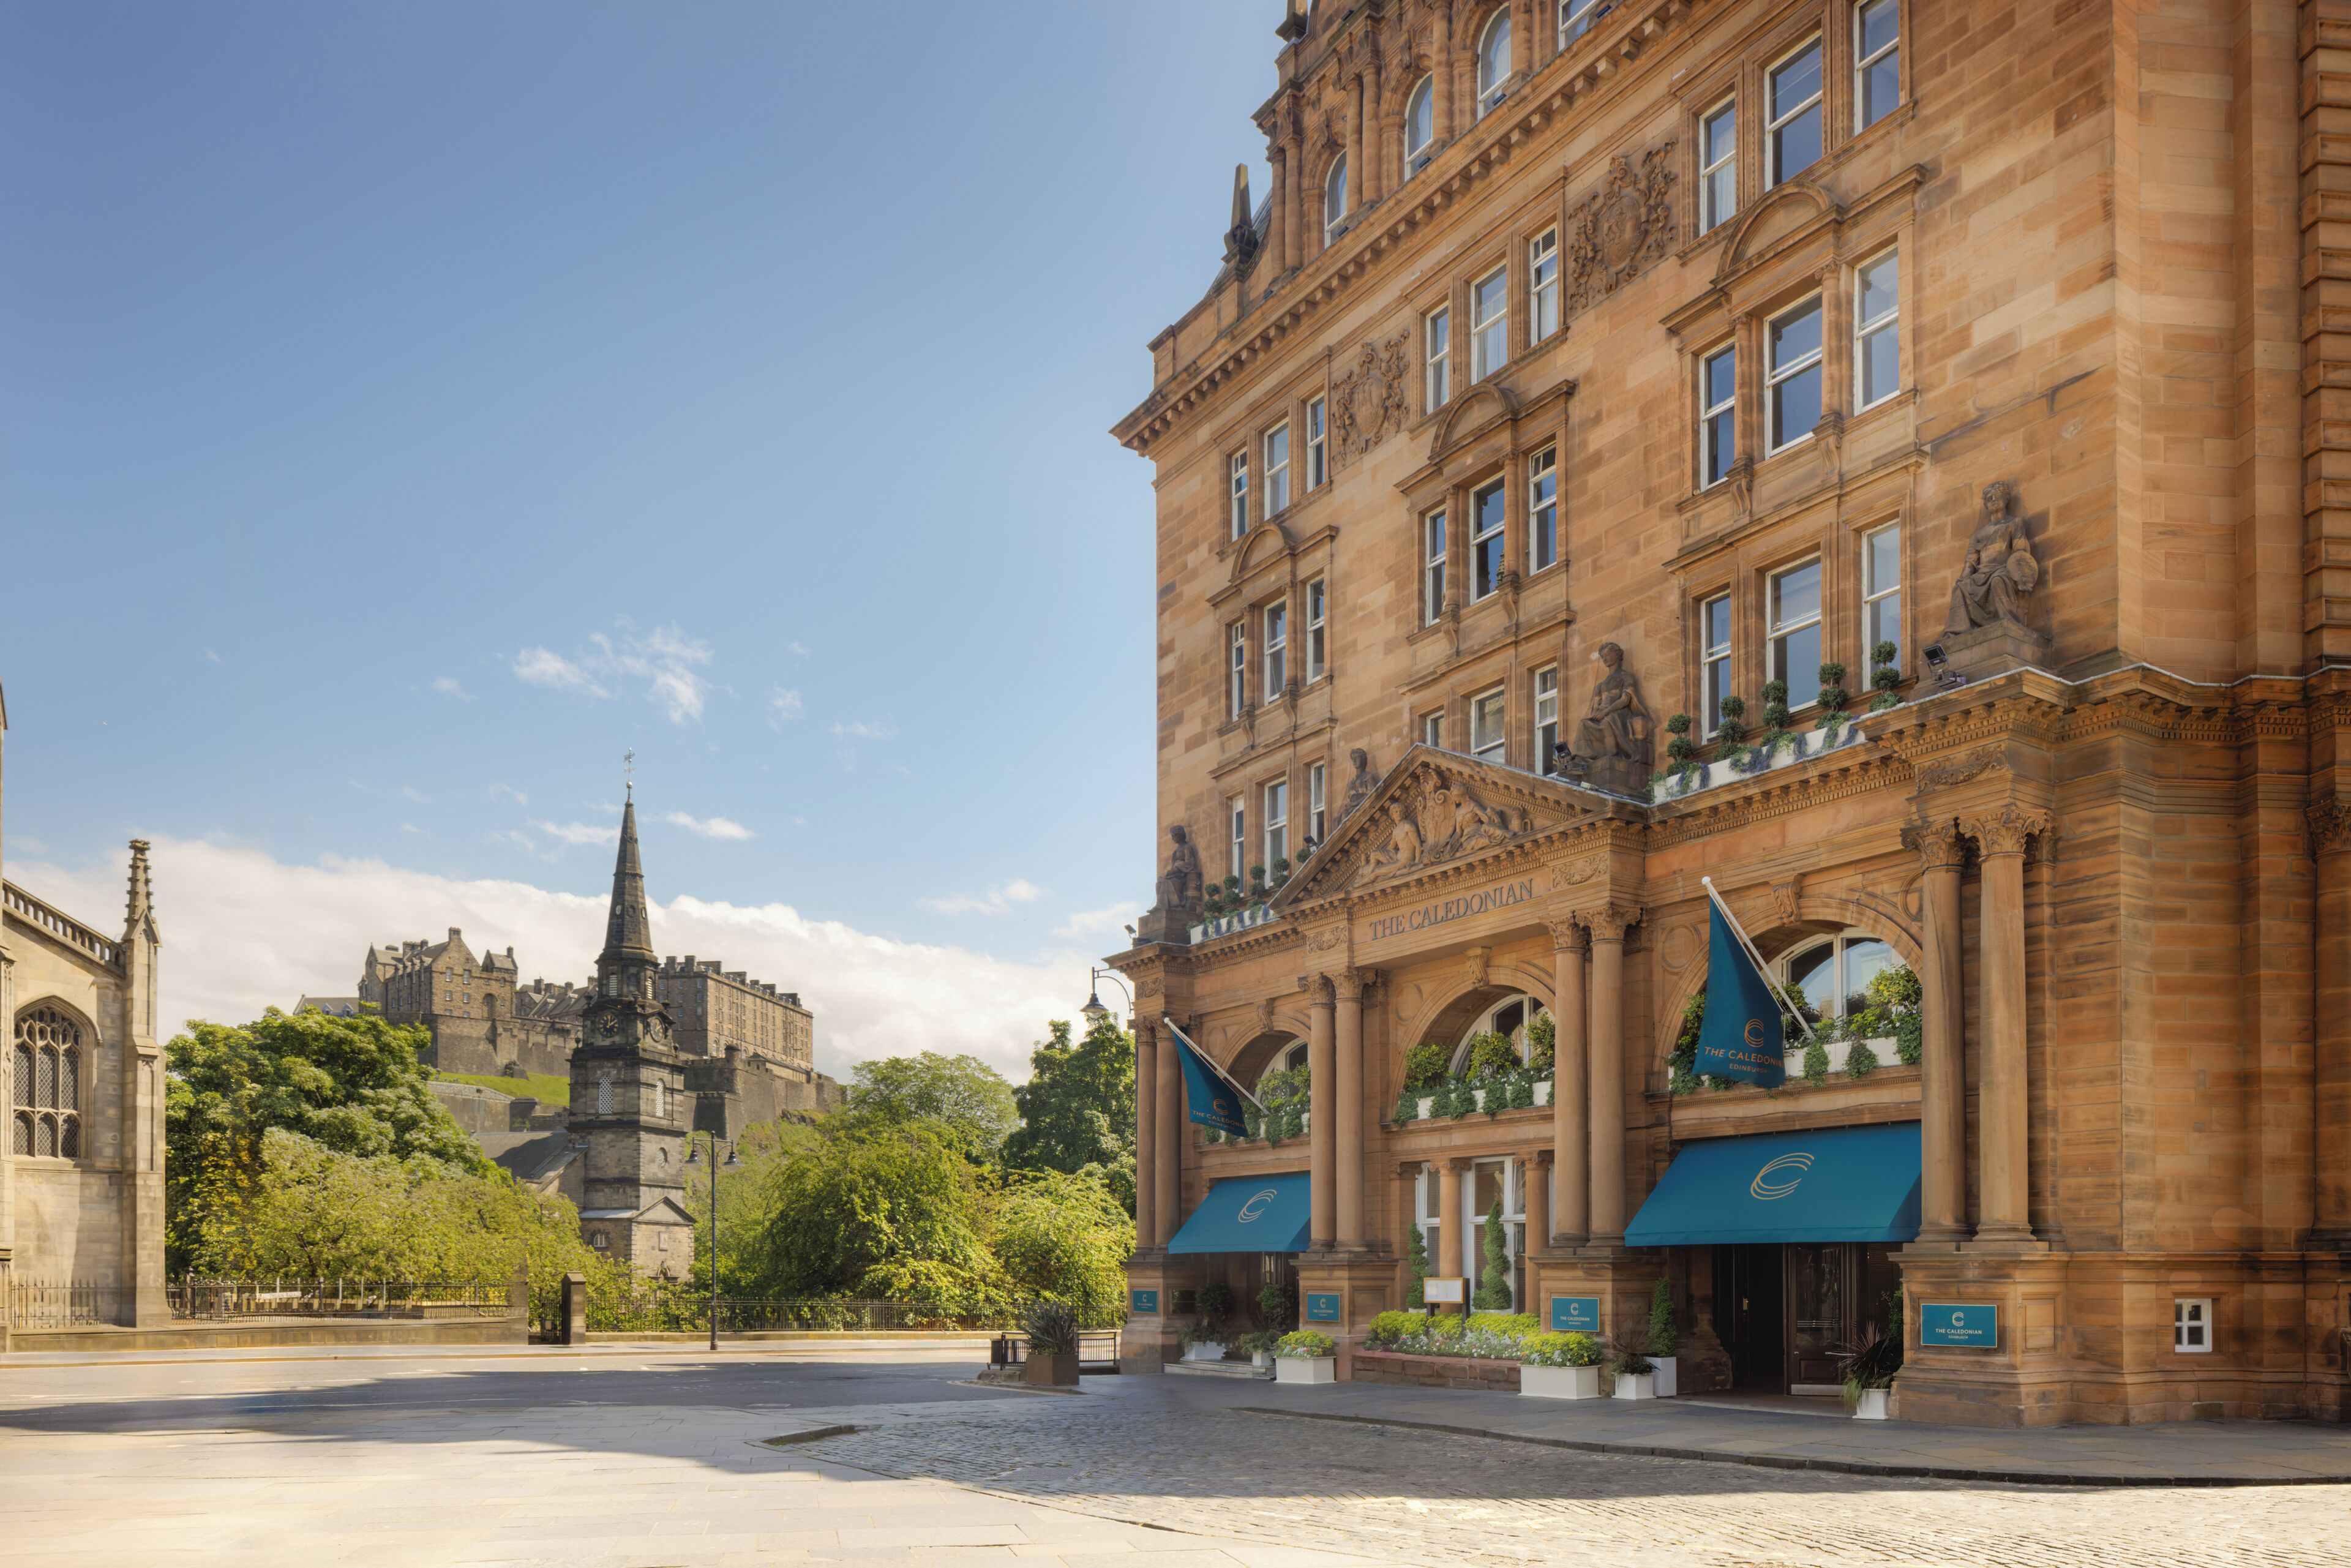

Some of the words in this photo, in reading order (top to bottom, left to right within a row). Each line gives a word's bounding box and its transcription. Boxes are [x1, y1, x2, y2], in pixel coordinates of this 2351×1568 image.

[1369, 913, 1404, 940] THE
[1409, 879, 1534, 931] CALEDONIAN
[1704, 1046, 1725, 1057] THE
